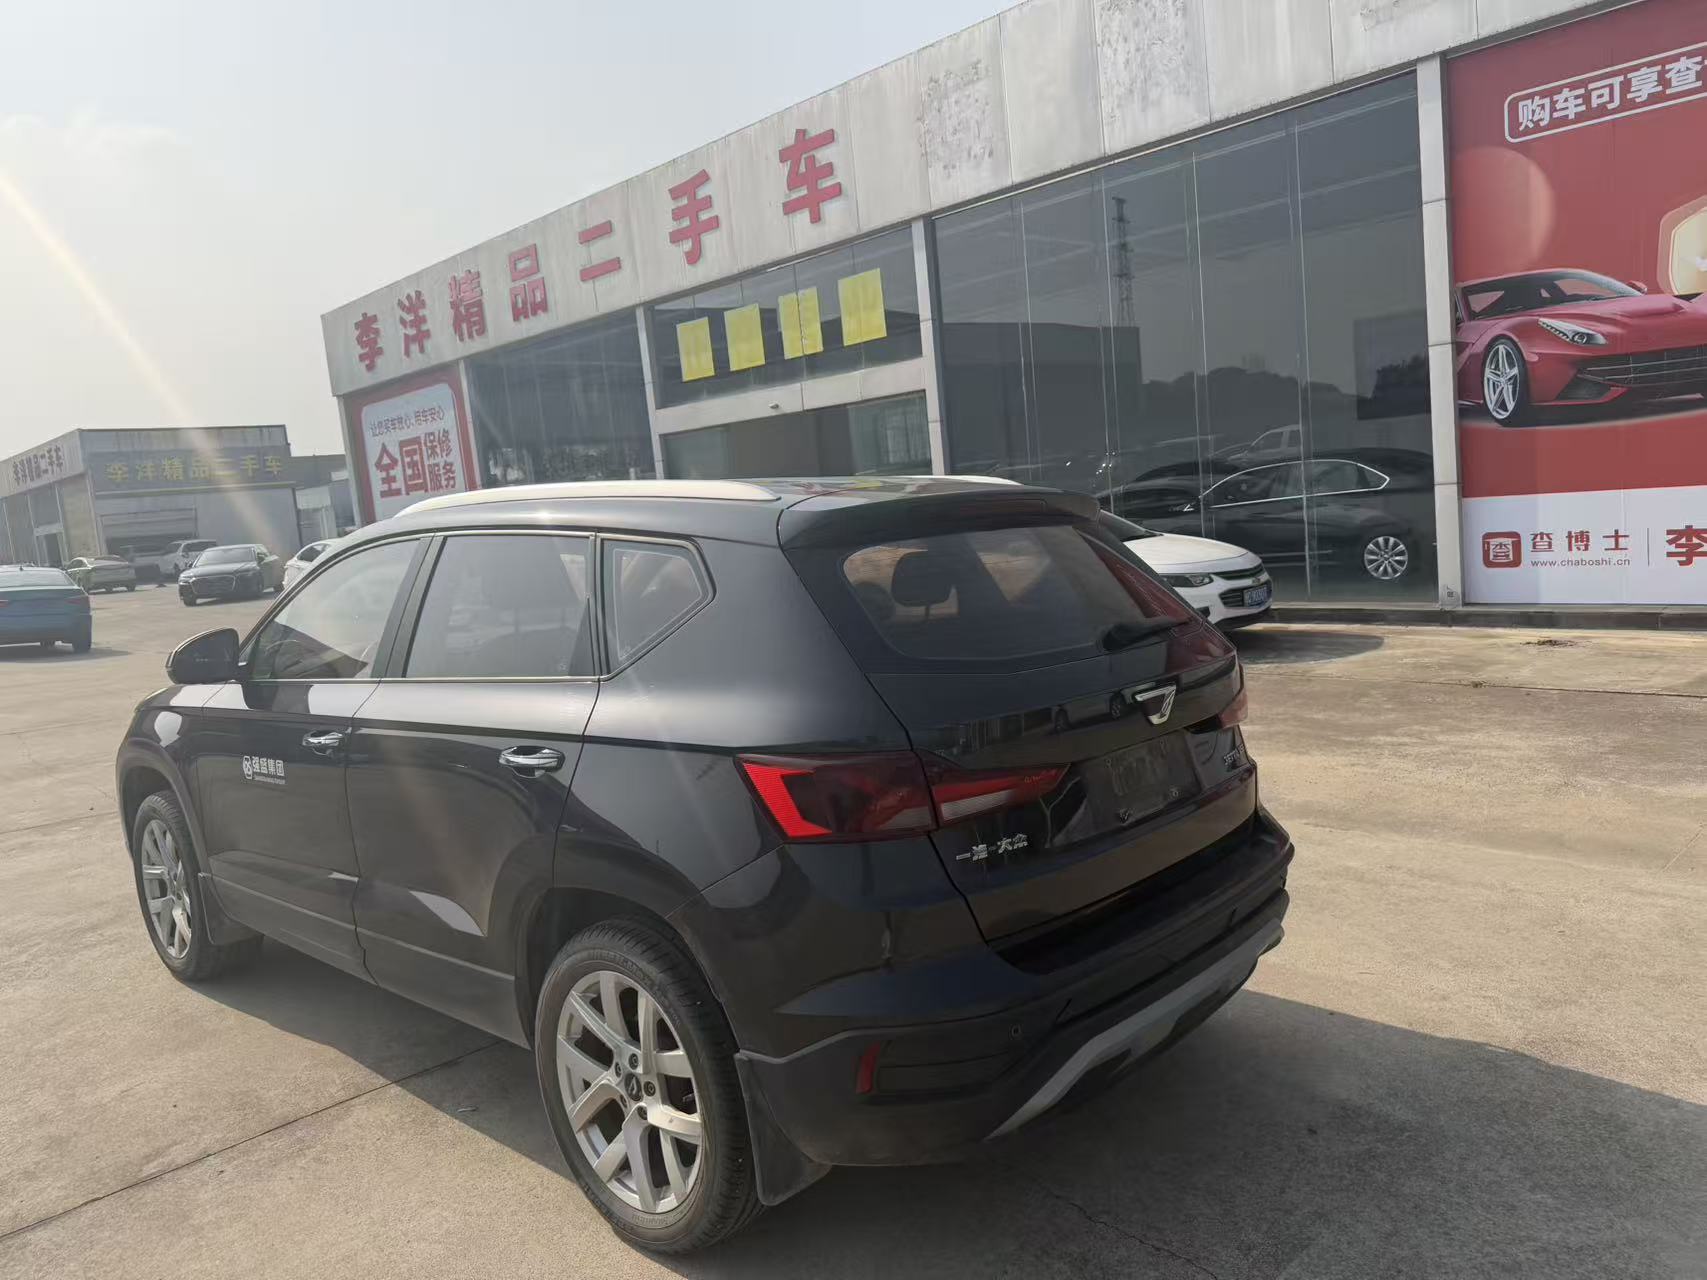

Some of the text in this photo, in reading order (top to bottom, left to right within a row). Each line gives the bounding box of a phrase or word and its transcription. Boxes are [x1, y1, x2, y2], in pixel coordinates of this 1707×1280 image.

[1518, 56, 1707, 131] 购车可享查
[354, 128, 843, 373] 李洋精品二手车
[424, 428, 453, 462] 保修
[104, 454, 283, 483] 李洋精品二手车
[375, 436, 429, 498] 全国
[428, 460, 456, 492] 服务
[1529, 529, 1631, 553] 查博士
[1666, 525, 1707, 566] 李
[1530, 557, 1631, 567] www.chaboshi.cn
